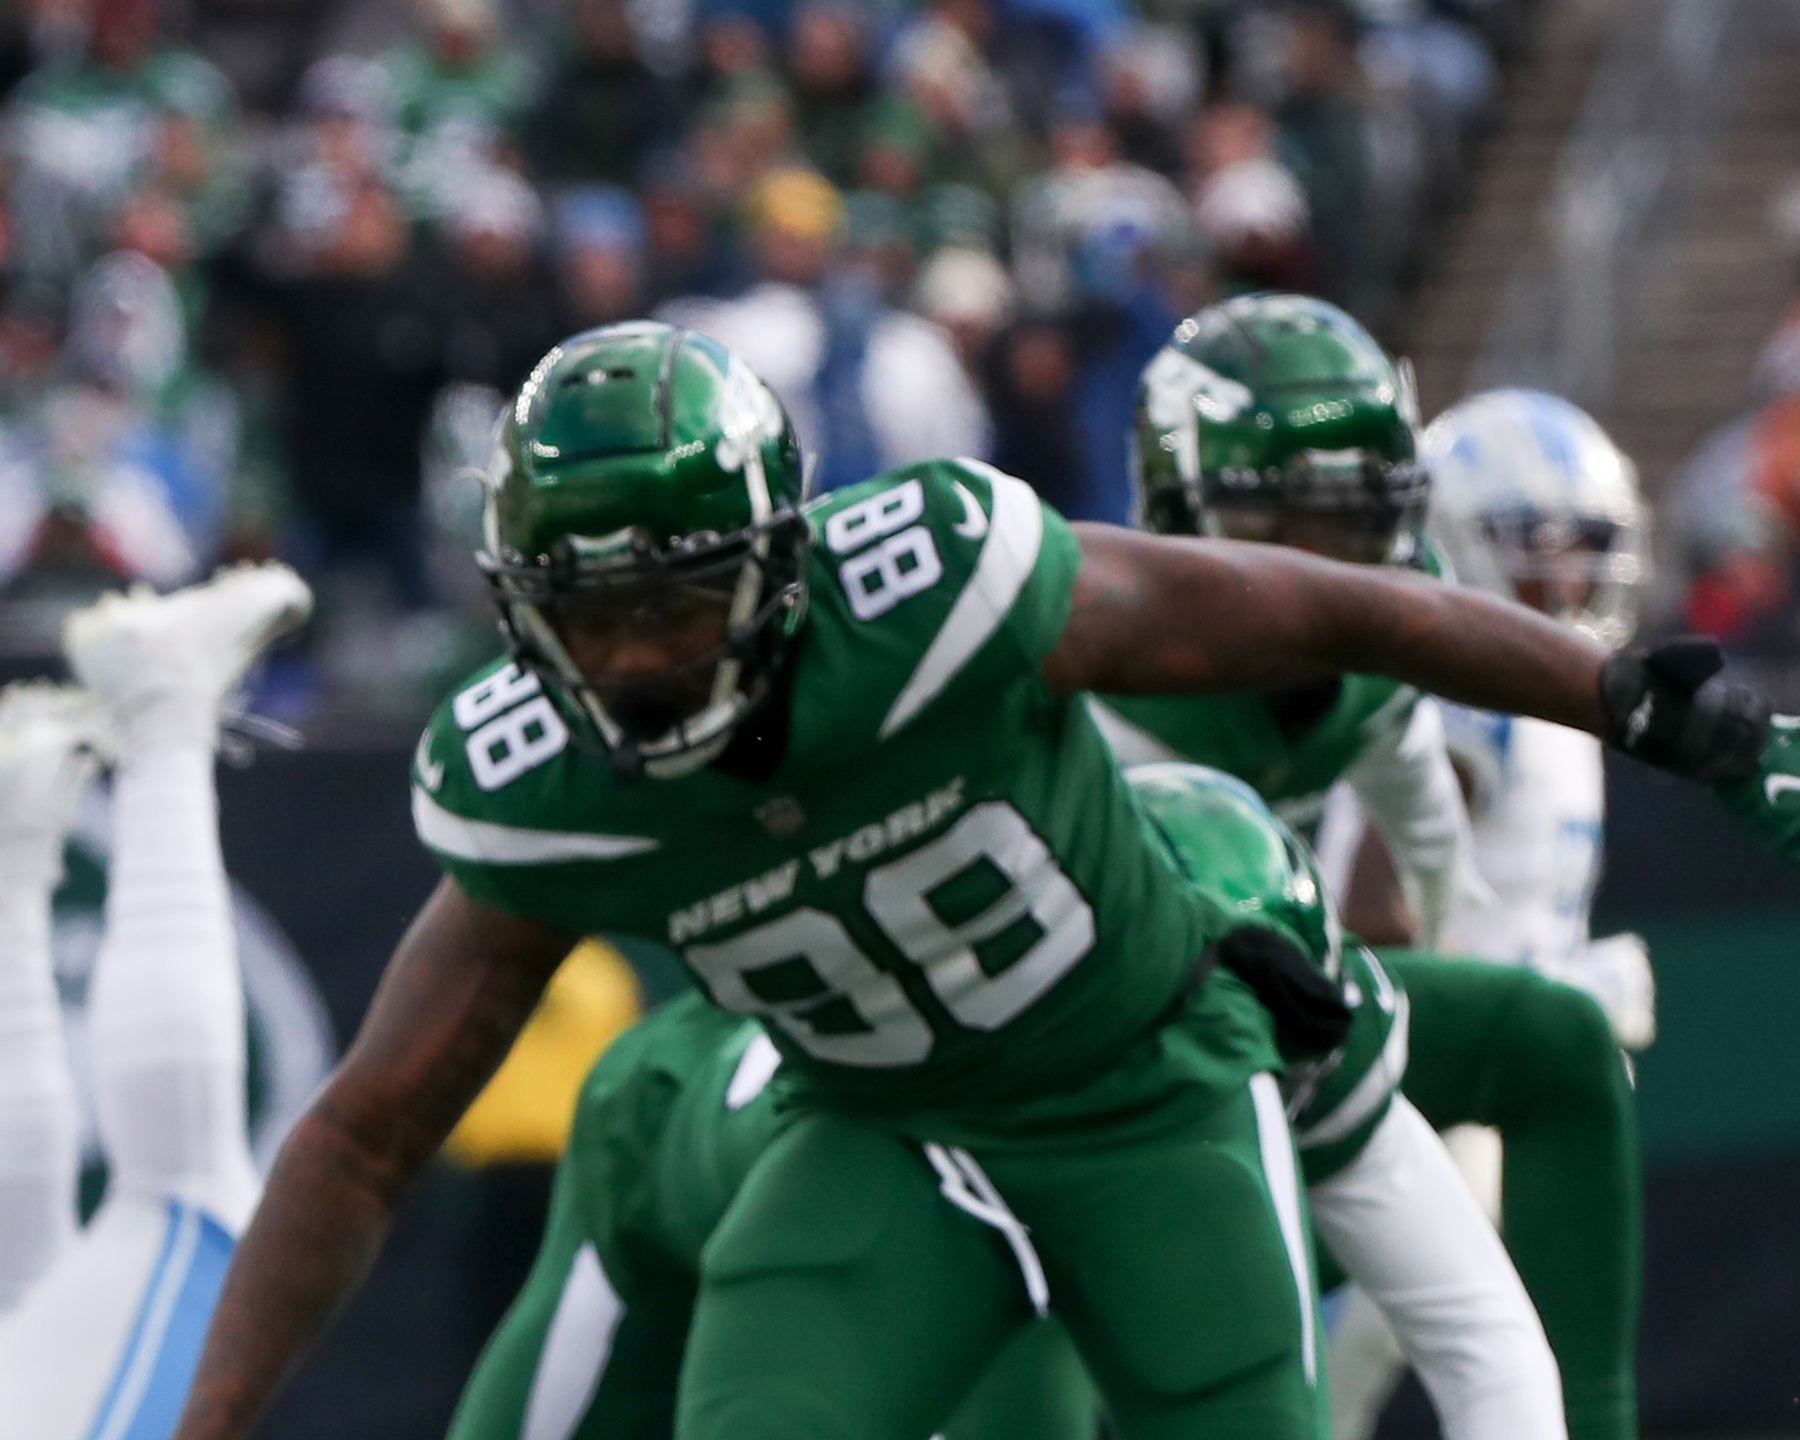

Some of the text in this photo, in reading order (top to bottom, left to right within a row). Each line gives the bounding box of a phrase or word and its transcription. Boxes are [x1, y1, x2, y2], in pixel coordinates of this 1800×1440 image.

[823, 477, 944, 622] 88
[452, 662, 570, 793] 88
[667, 859, 800, 945] NEW
[808, 776, 965, 881] YORK
[684, 798, 1098, 1068] 88
